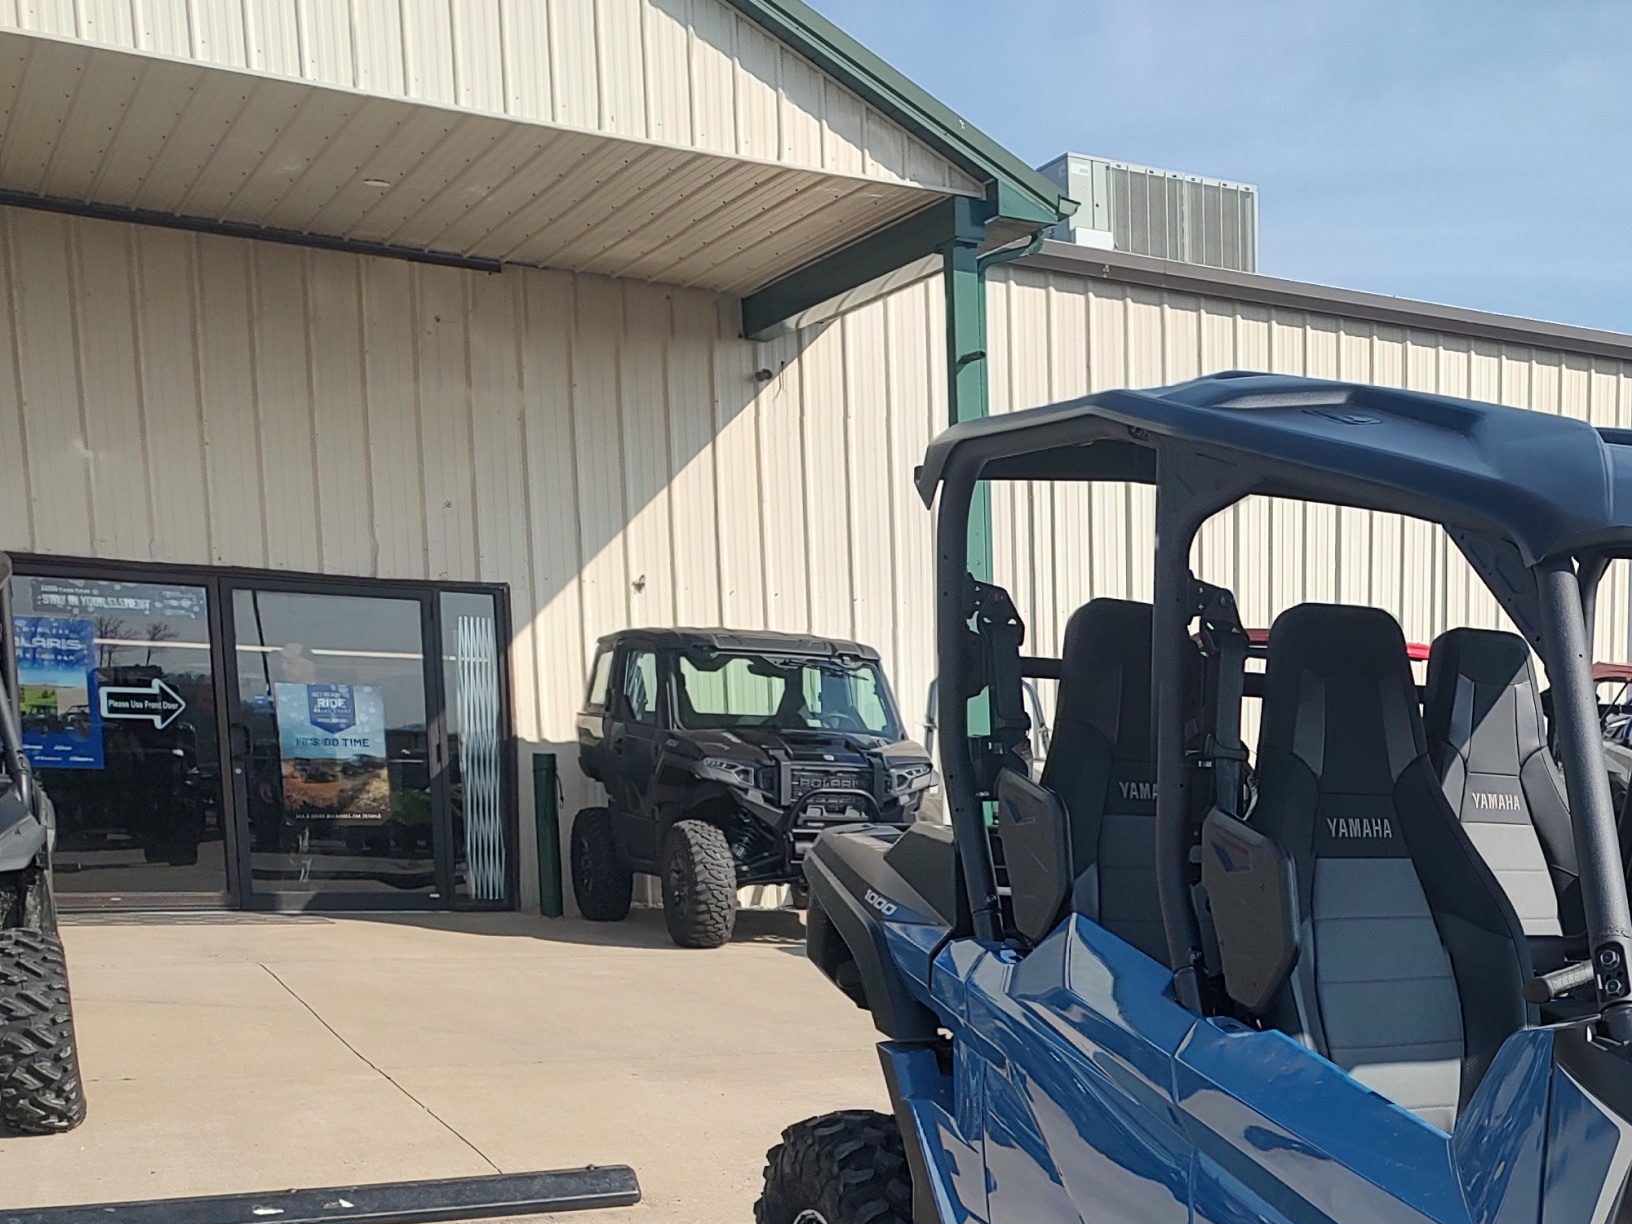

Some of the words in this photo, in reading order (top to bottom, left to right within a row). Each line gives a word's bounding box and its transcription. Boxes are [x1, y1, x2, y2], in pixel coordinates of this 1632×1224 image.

[108, 699, 131, 709] Please
[131, 700, 143, 709] Use
[144, 700, 162, 709] Front
[162, 701, 179, 710] Door
[317, 698, 347, 709] RIDE
[342, 738, 370, 747] TIME
[1471, 792, 1521, 811] YAMAHA
[1326, 817, 1393, 839] YAMAHA
[864, 888, 898, 916] 1000
